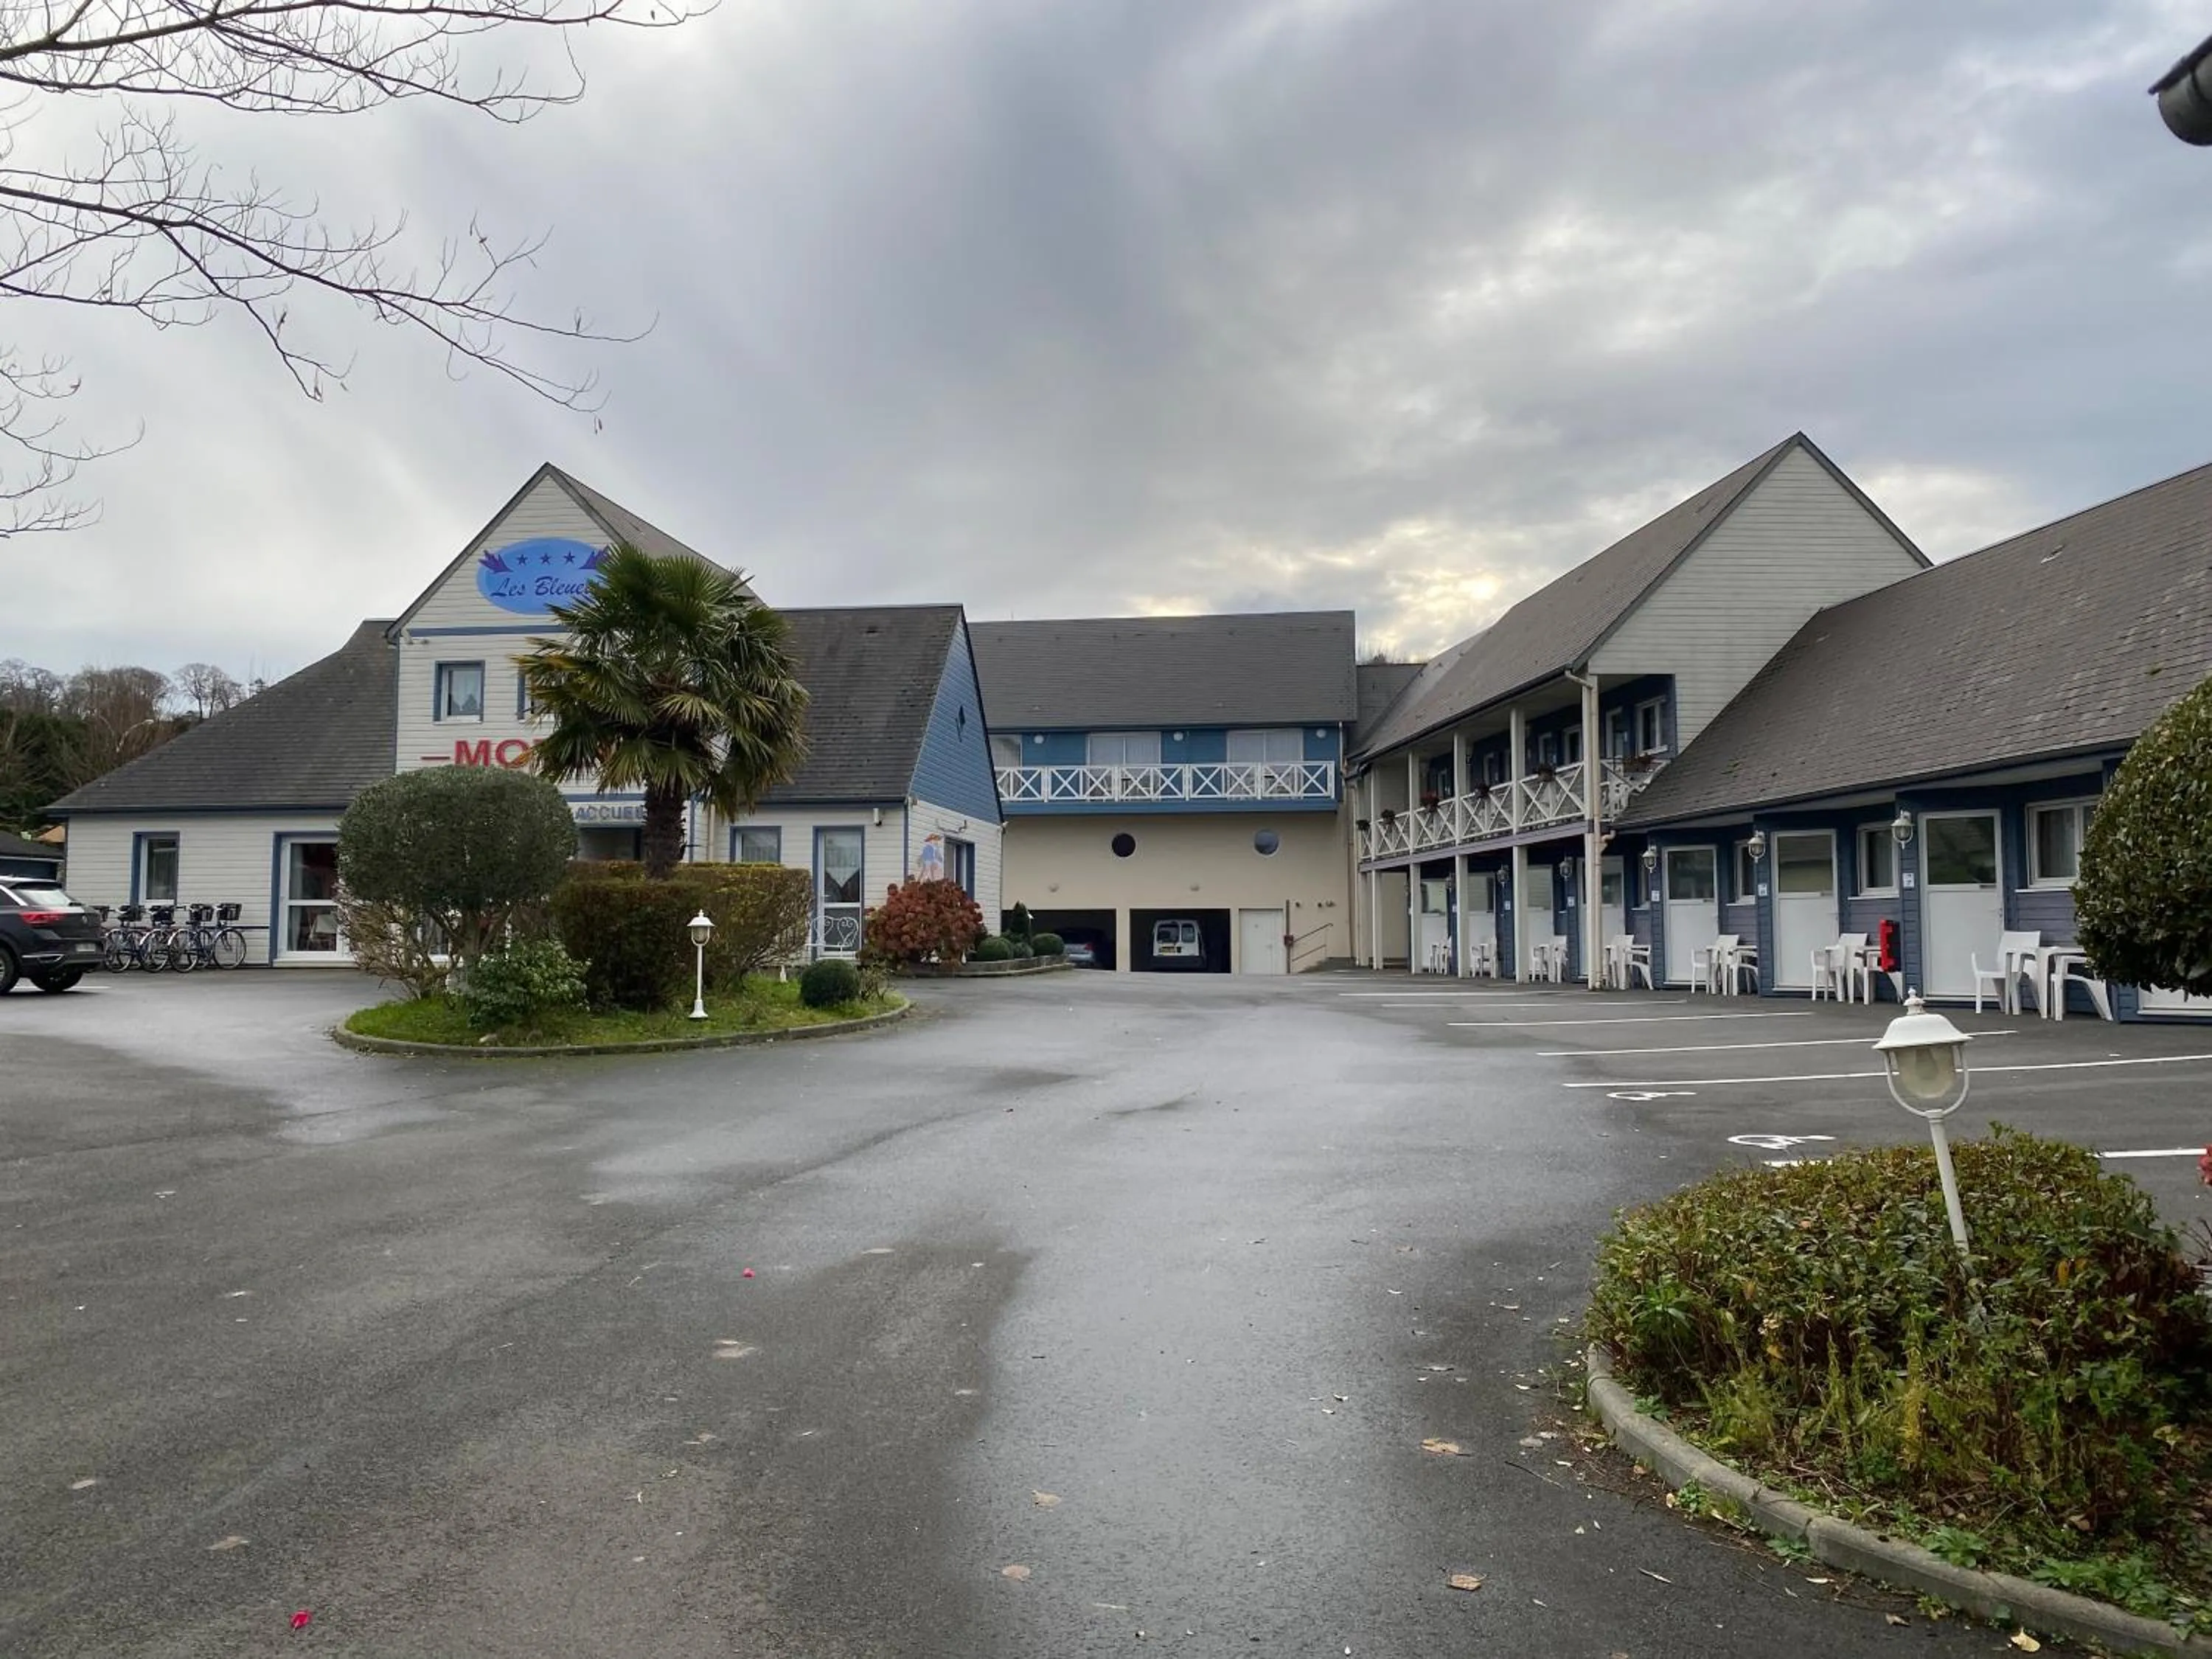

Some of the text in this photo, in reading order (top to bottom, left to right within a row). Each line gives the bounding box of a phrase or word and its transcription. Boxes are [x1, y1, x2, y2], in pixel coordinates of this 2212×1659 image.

[490, 575, 590, 596] Les Bleue
[454, 739, 545, 768] MO
